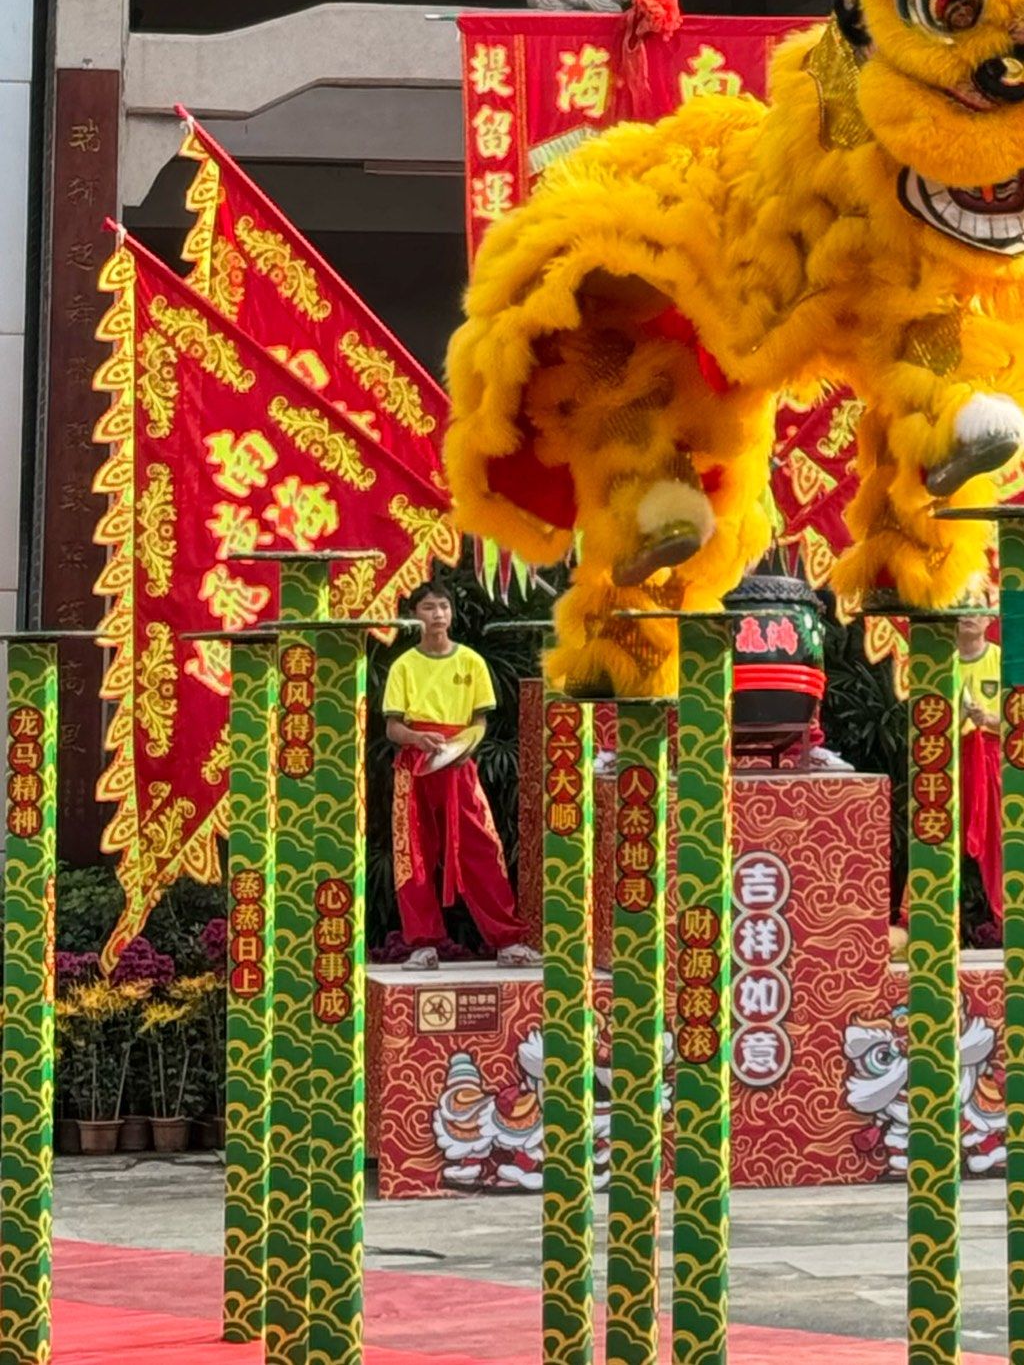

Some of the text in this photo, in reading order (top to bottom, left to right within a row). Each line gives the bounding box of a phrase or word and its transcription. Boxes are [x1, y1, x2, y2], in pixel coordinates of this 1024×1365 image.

[12, 709, 40, 833] 龙马精神
[283, 648, 311, 775] 春风得意
[549, 704, 578, 830] 六六大顺
[919, 699, 949, 841] 岁岁平安
[621, 771, 651, 909] 人杰地灵
[232, 873, 262, 993] 蒸蒸日上
[318, 884, 348, 1019] 心想事成
[683, 910, 714, 1059] 财源滚滚
[740, 862, 781, 1073] 吉祥如意
